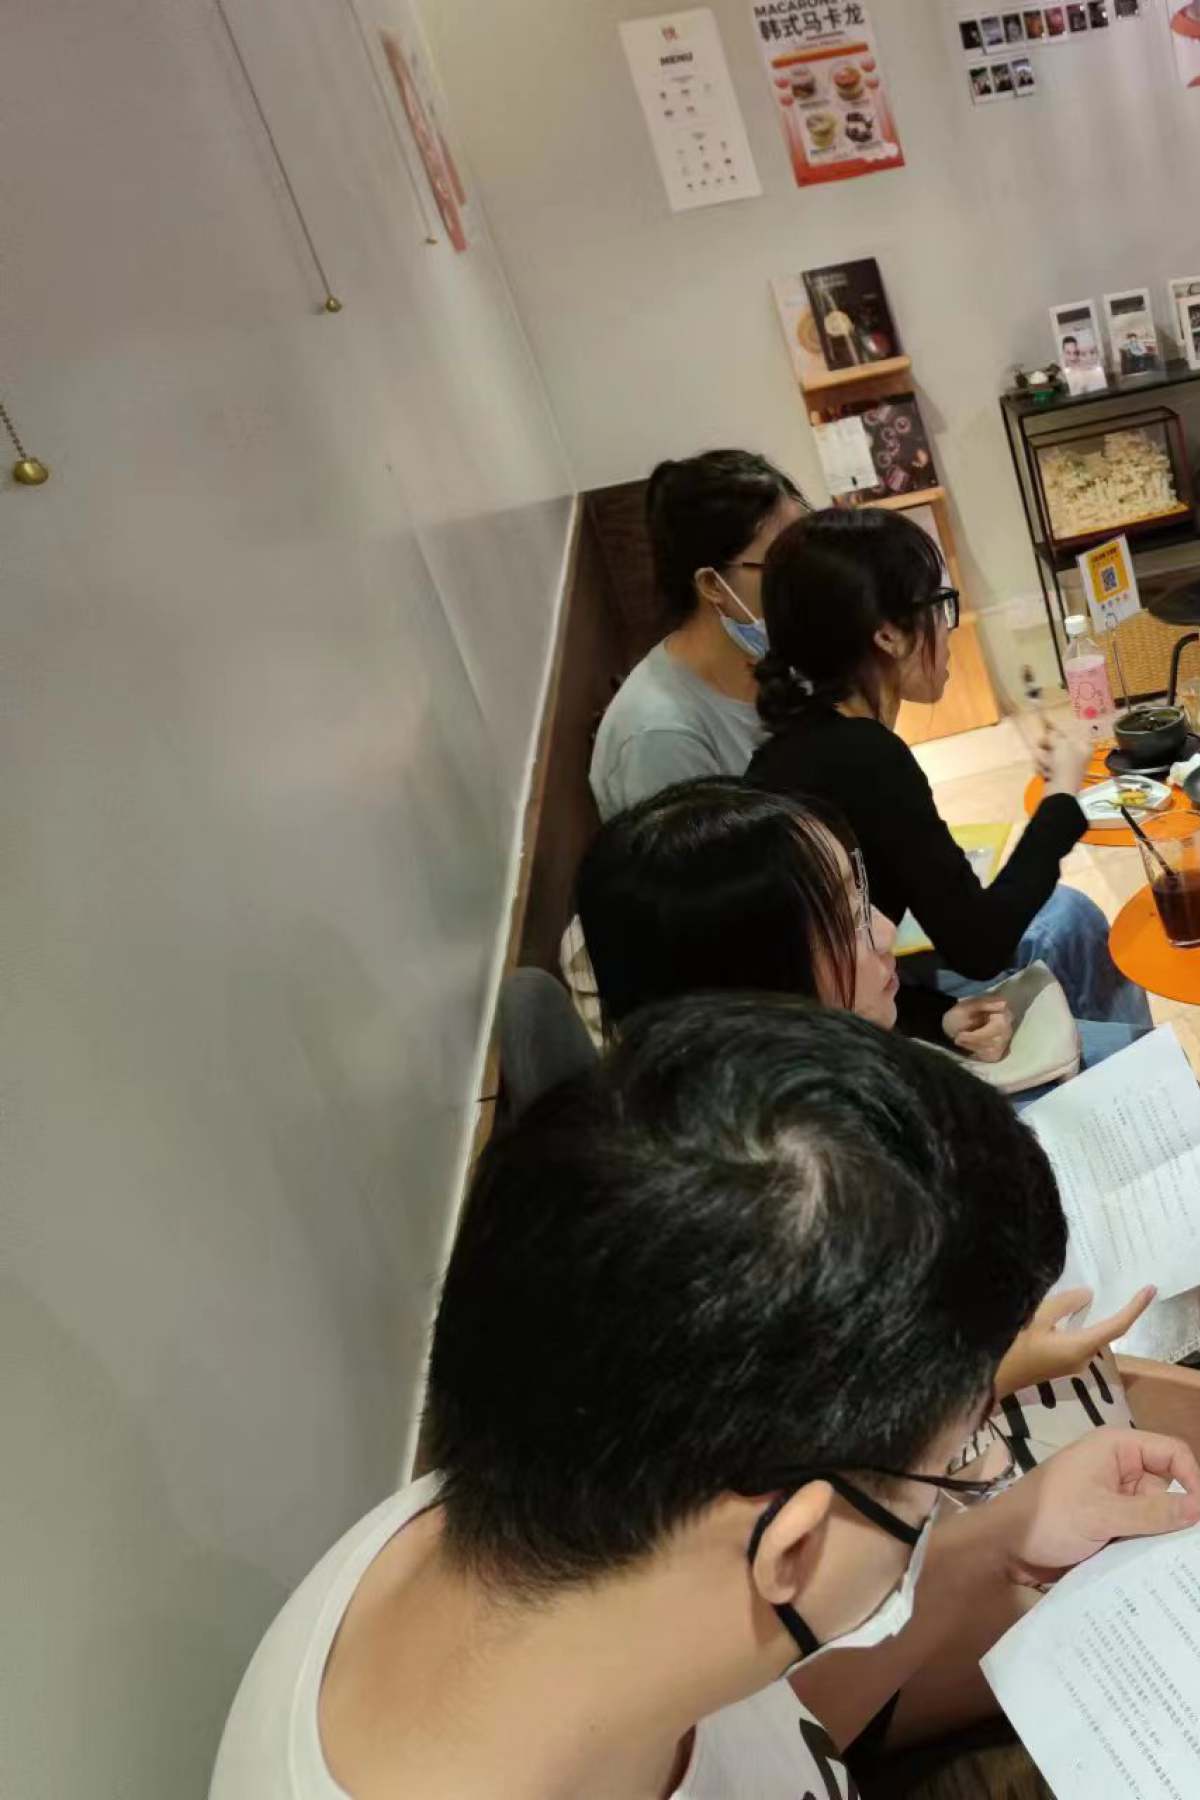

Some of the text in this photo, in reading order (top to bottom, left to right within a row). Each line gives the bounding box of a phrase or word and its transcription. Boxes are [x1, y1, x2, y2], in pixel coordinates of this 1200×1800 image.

[754, 0, 840, 18] MACARON
[759, 3, 865, 42] 韩式马卡龙
[660, 52, 694, 67] MENU
